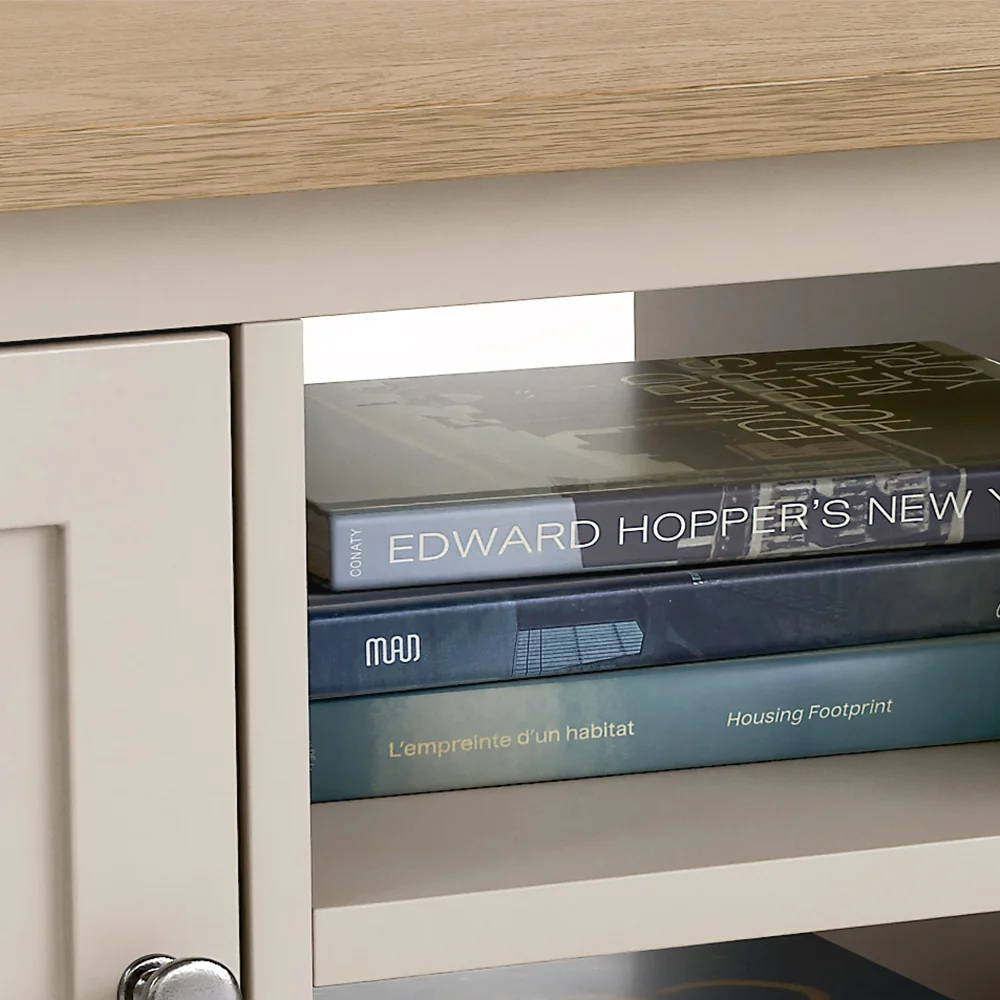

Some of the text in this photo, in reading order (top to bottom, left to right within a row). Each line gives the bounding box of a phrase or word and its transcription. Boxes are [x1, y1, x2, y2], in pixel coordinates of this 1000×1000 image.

[776, 360, 931, 396] NEW
[620, 372, 845, 441] EDWARD
[388, 518, 601, 565] EDWARD
[618, 498, 851, 546] HOPPER'S
[868, 489, 973, 526] NEW
[349, 527, 363, 578] CONATY
[726, 698, 893, 726] Housing Footprint
[388, 719, 636, 758] L'empreinte d'un habitat
